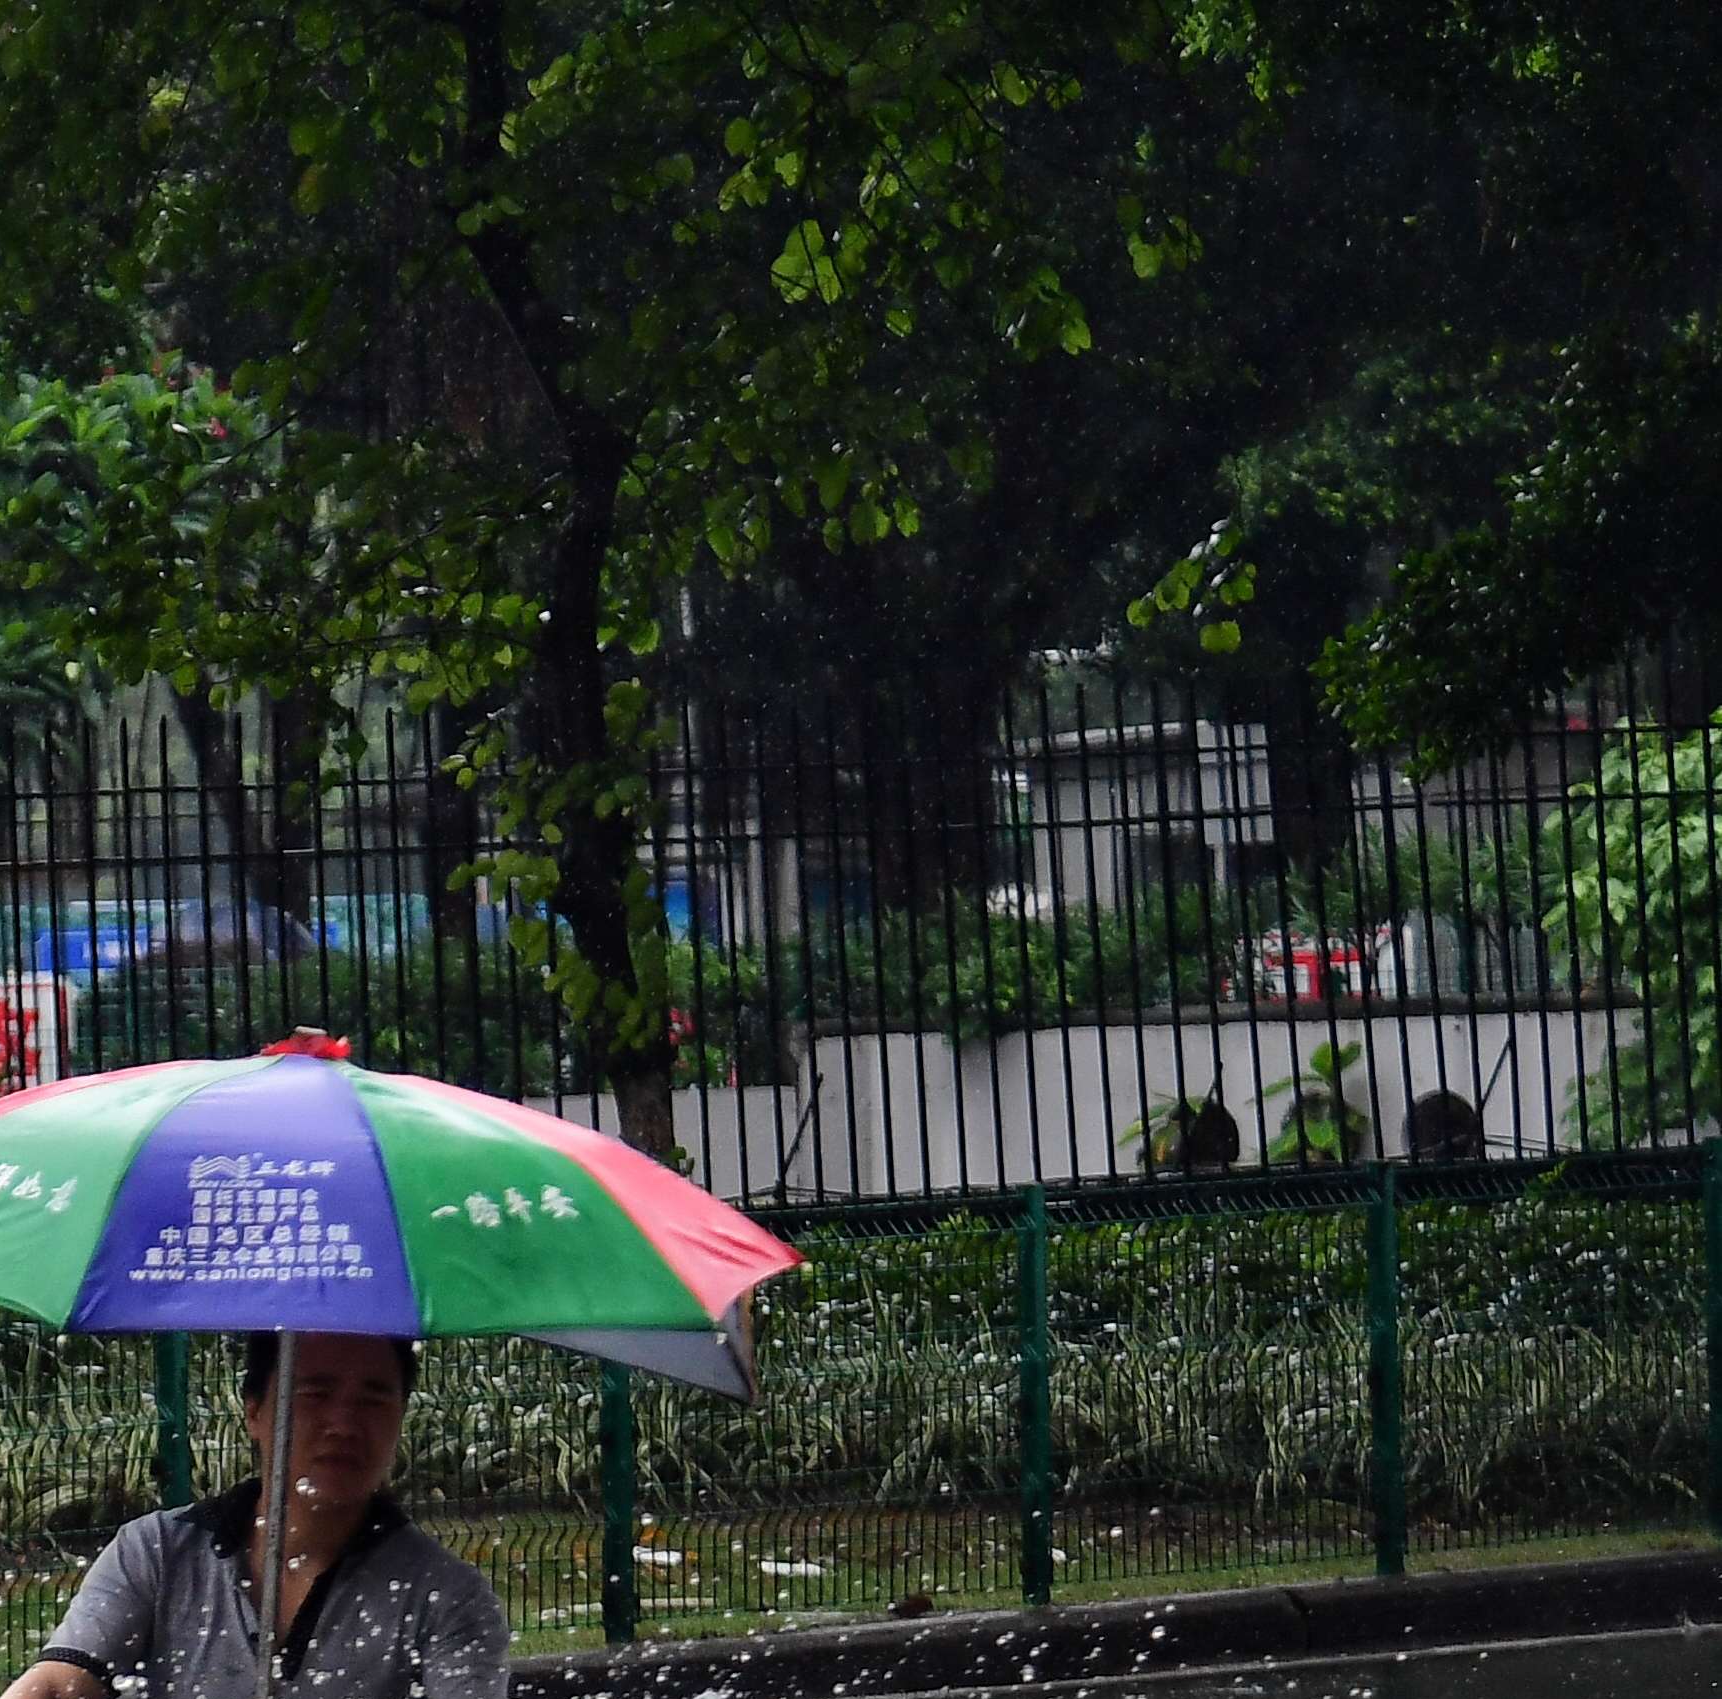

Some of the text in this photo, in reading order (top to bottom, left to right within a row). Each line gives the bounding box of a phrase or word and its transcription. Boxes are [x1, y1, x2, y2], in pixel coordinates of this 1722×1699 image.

[159, 1223, 350, 1246] 中国地区总经销
